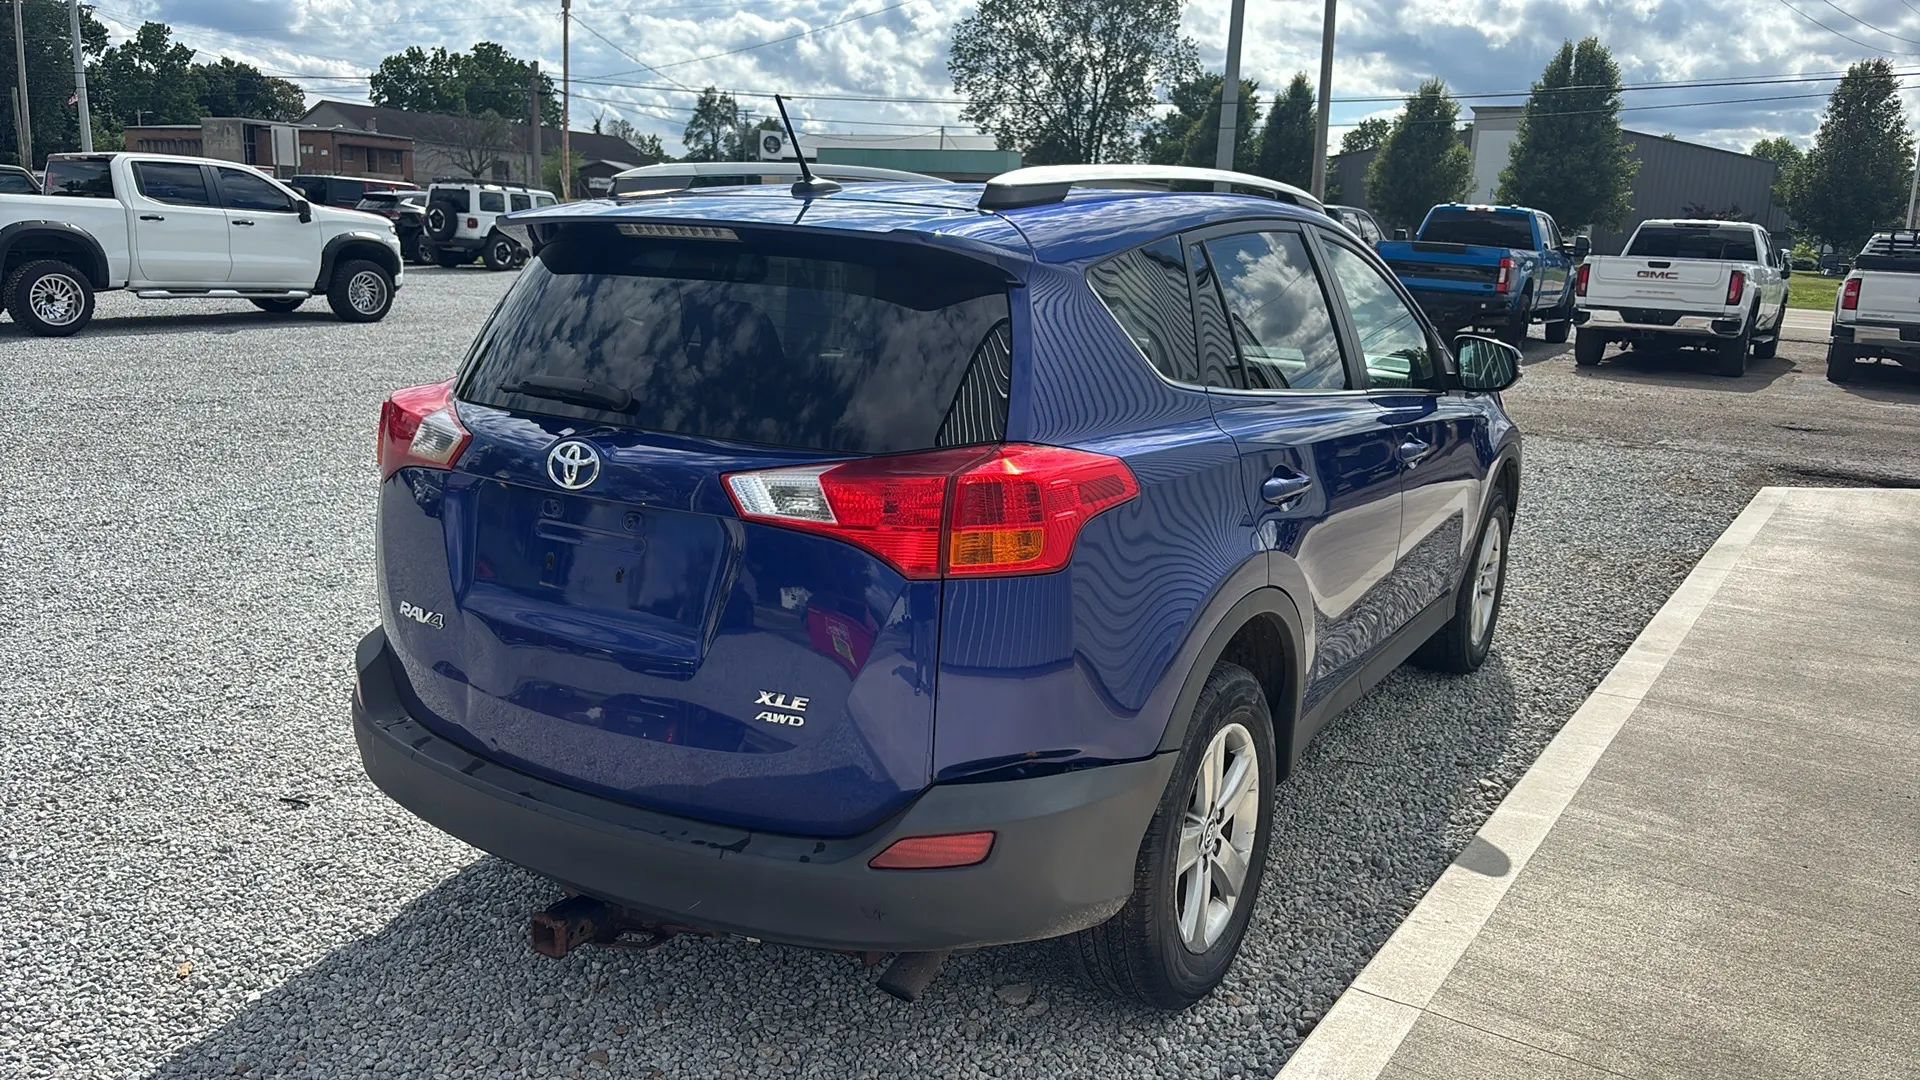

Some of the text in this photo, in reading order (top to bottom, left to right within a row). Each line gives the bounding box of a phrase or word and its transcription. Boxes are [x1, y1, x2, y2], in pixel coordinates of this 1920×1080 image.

[1637, 270, 1679, 280] GMC
[400, 600, 444, 630] RAV4
[754, 690, 810, 711] XLE
[754, 711, 805, 727] AWD
